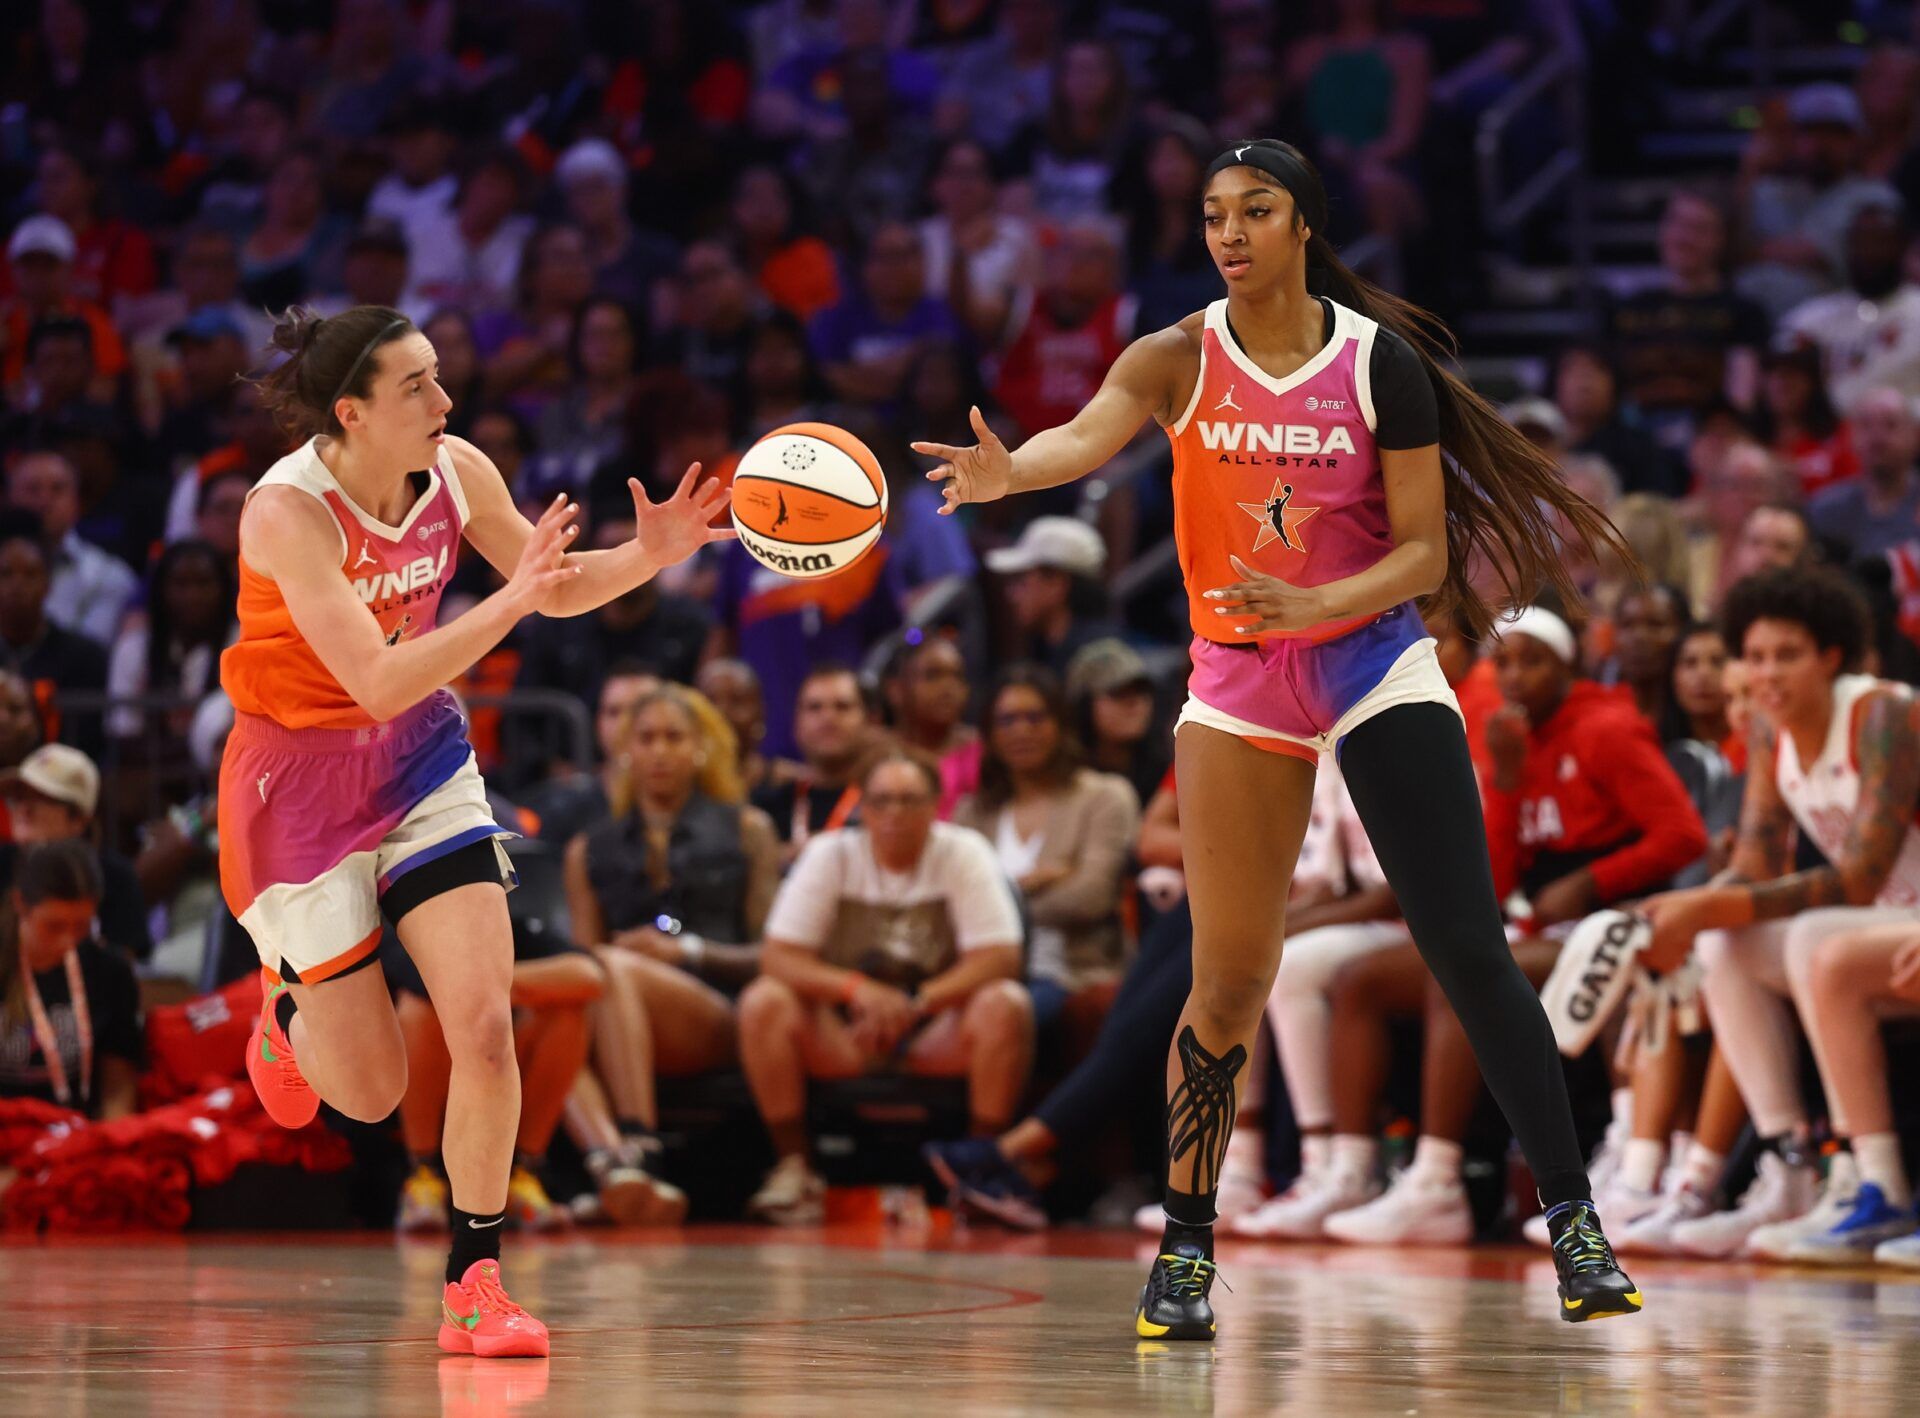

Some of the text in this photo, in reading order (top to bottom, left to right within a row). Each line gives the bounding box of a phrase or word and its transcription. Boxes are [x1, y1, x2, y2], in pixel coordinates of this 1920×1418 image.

[1320, 400, 1347, 411] AT&T
[1196, 420, 1357, 455] WNBA
[1218, 454, 1338, 469] ALL-STAR
[740, 531, 836, 572] Wilson
[372, 578, 443, 615] LL-STA
